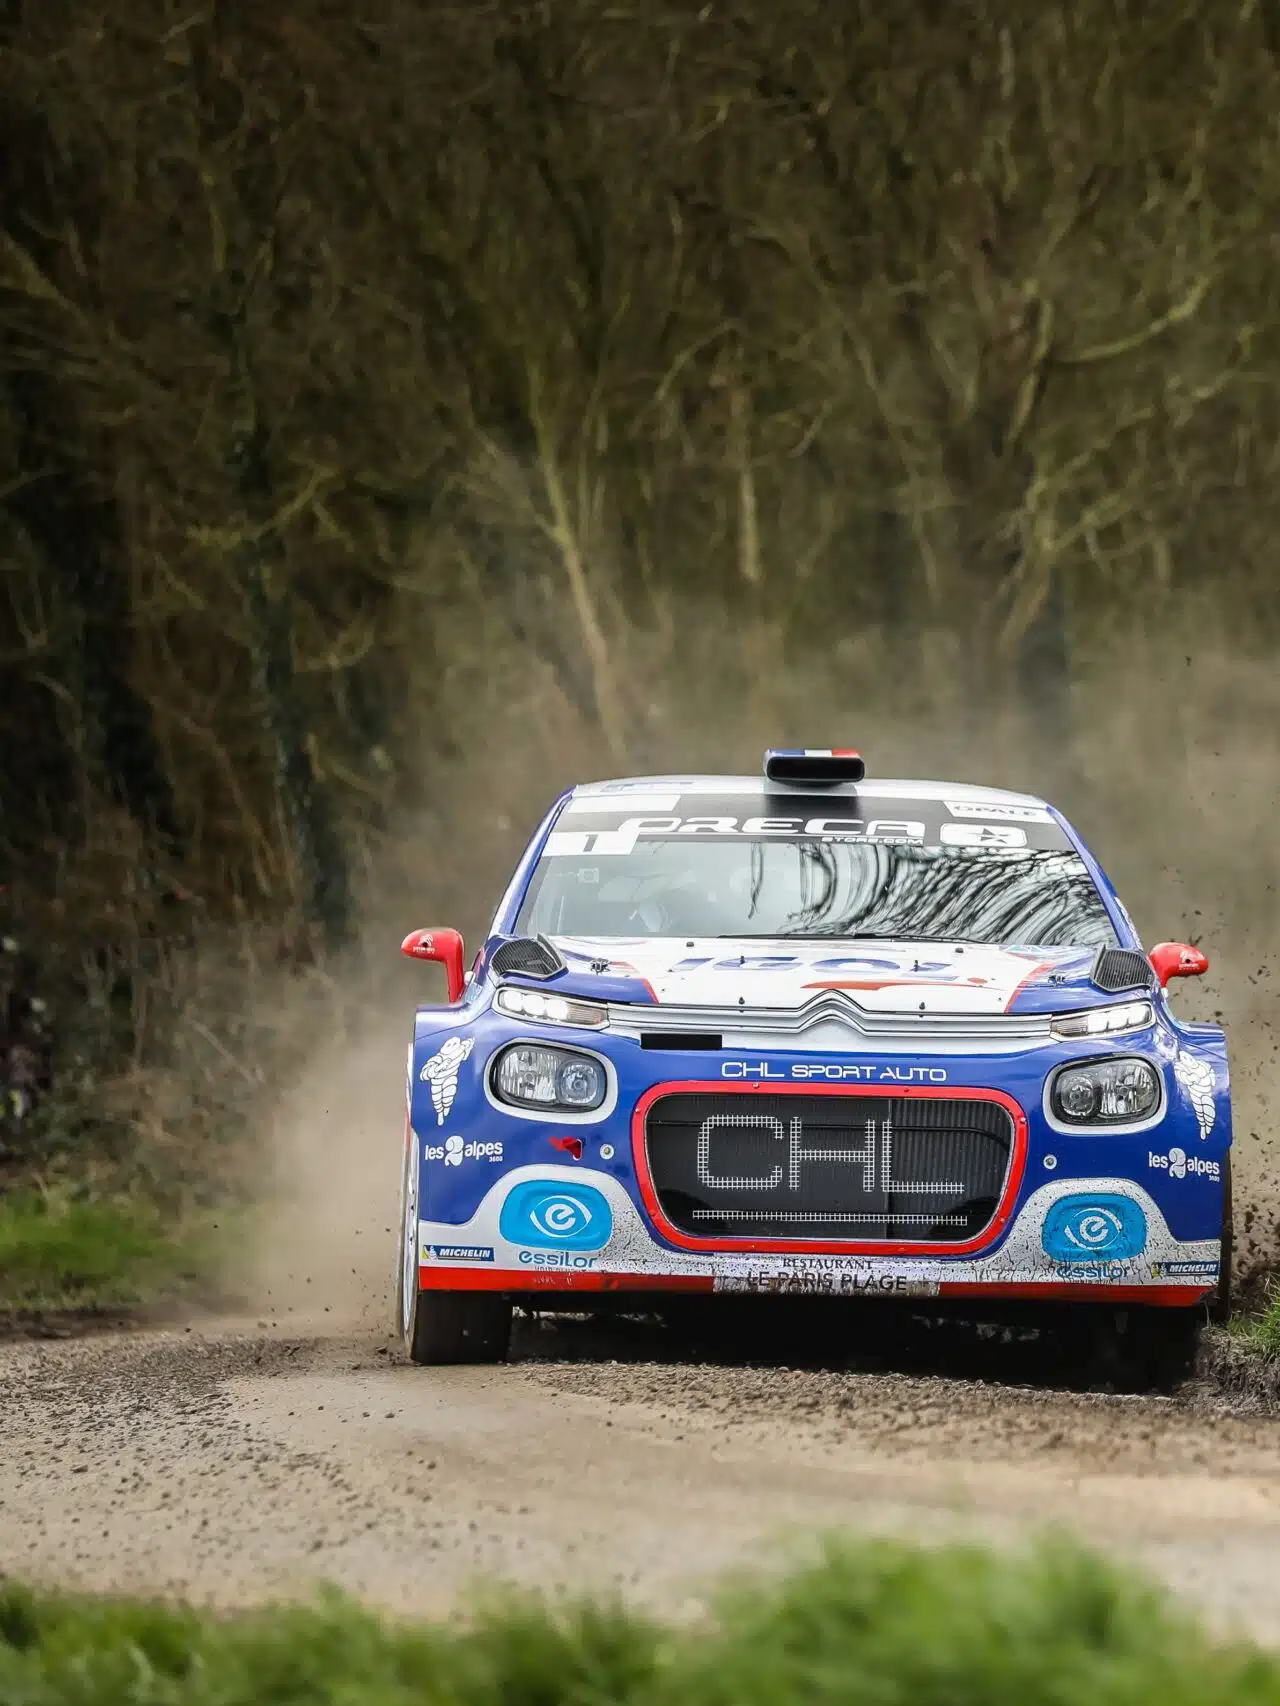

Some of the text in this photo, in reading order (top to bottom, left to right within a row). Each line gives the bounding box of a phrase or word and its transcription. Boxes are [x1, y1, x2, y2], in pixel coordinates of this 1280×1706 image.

[618, 816, 926, 837] ORECA
[582, 834, 599, 852] 1
[721, 1061, 947, 1082] CHL SPORT AUTO
[424, 1144, 445, 1161] les
[464, 1140, 504, 1161] alpes
[697, 1114, 965, 1194] CHL
[1148, 1150, 1169, 1169] les
[1186, 1156, 1221, 1177] alpes
[439, 1247, 491, 1258] MICHELIN
[518, 1250, 598, 1268] essilor
[783, 1257, 874, 1270] RESTAURANT
[1169, 1263, 1218, 1273] MICHELIN
[840, 1272, 908, 1291] PLAGE
